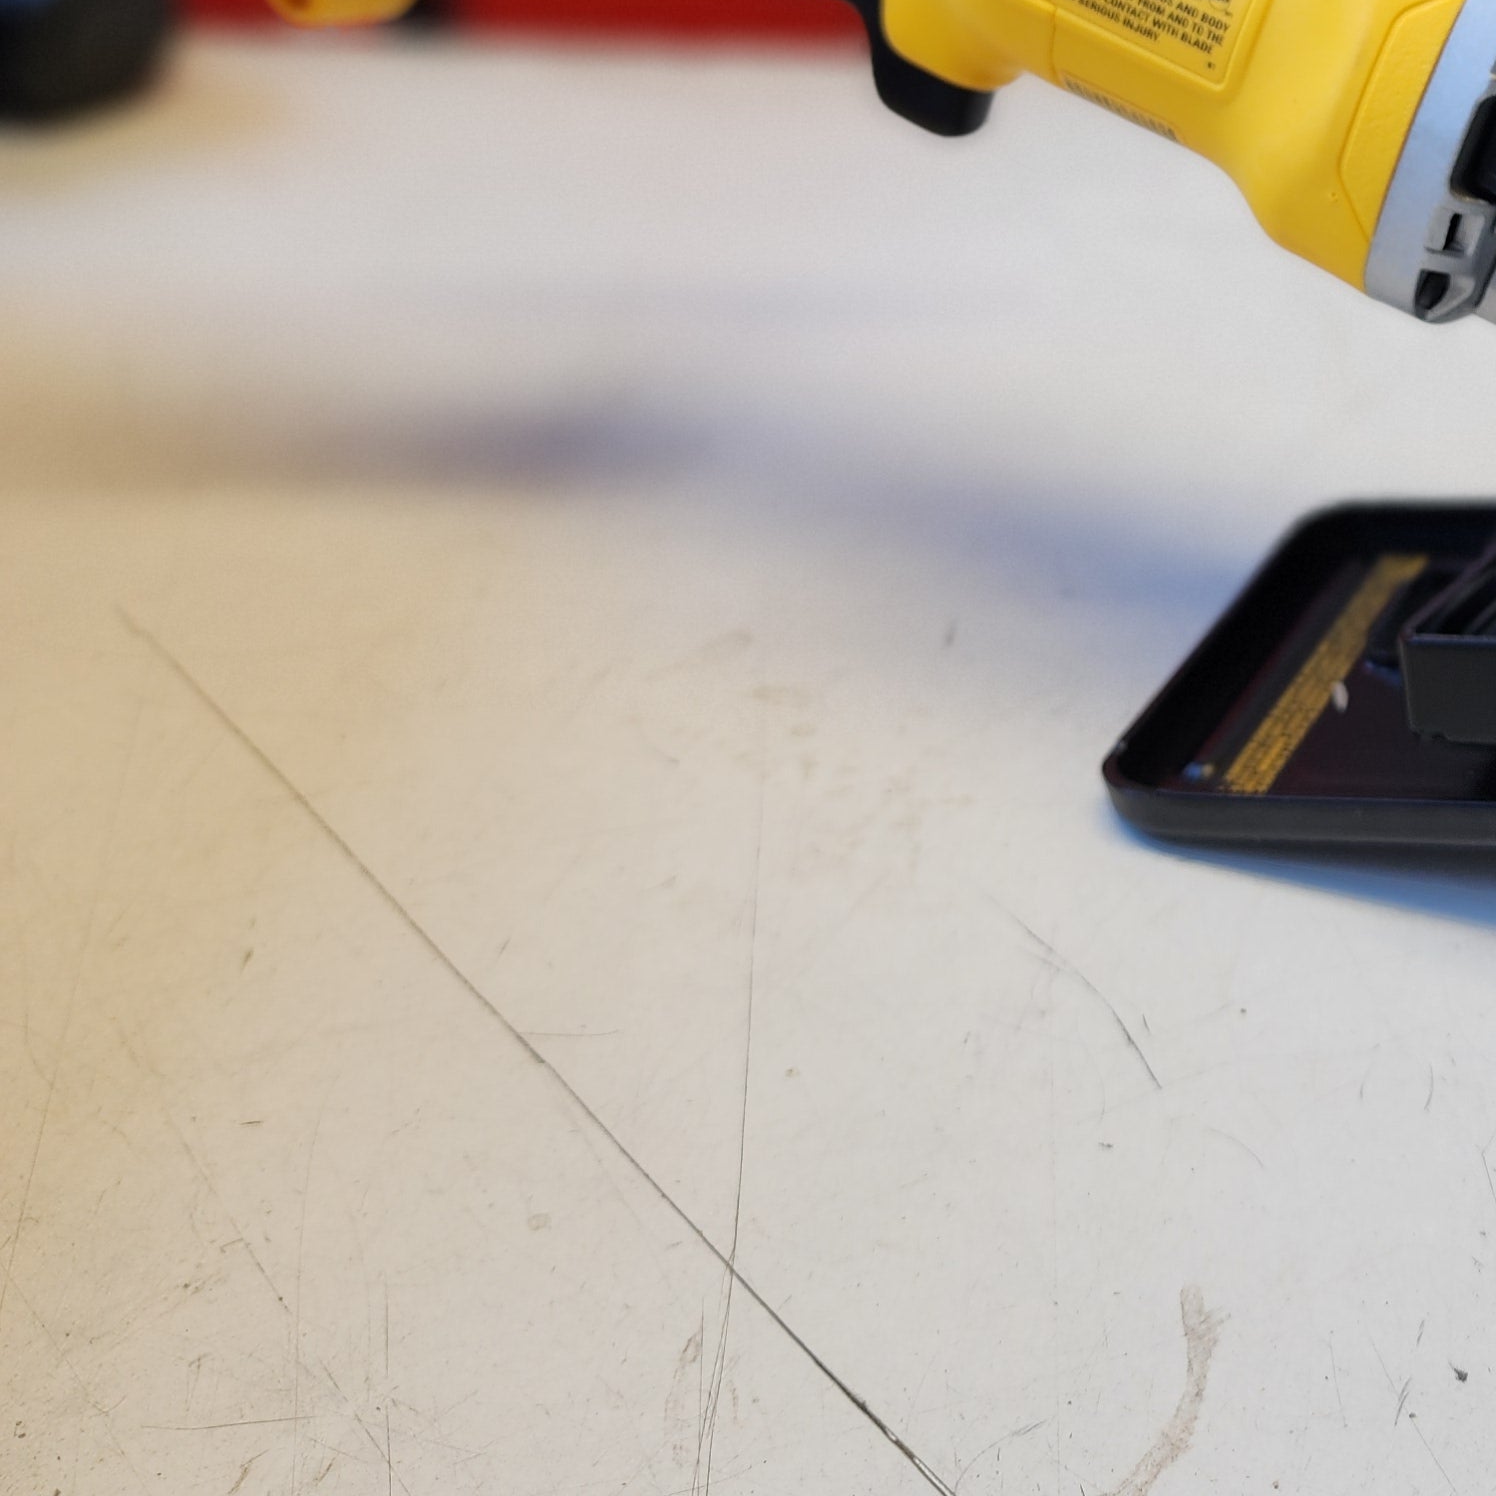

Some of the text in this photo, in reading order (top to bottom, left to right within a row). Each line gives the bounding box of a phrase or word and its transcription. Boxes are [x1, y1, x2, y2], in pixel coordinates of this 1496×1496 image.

[1122, 18, 1159, 41] INJURY
[1167, 12, 1189, 27] AND
[1192, 23, 1203, 34] TO
[1206, 31, 1224, 44] THE
[1176, 1, 1198, 17] AND
[1201, 13, 1229, 32] BODY
[1151, 17, 1179, 37] WITH
[1180, 32, 1213, 53] BLADE
